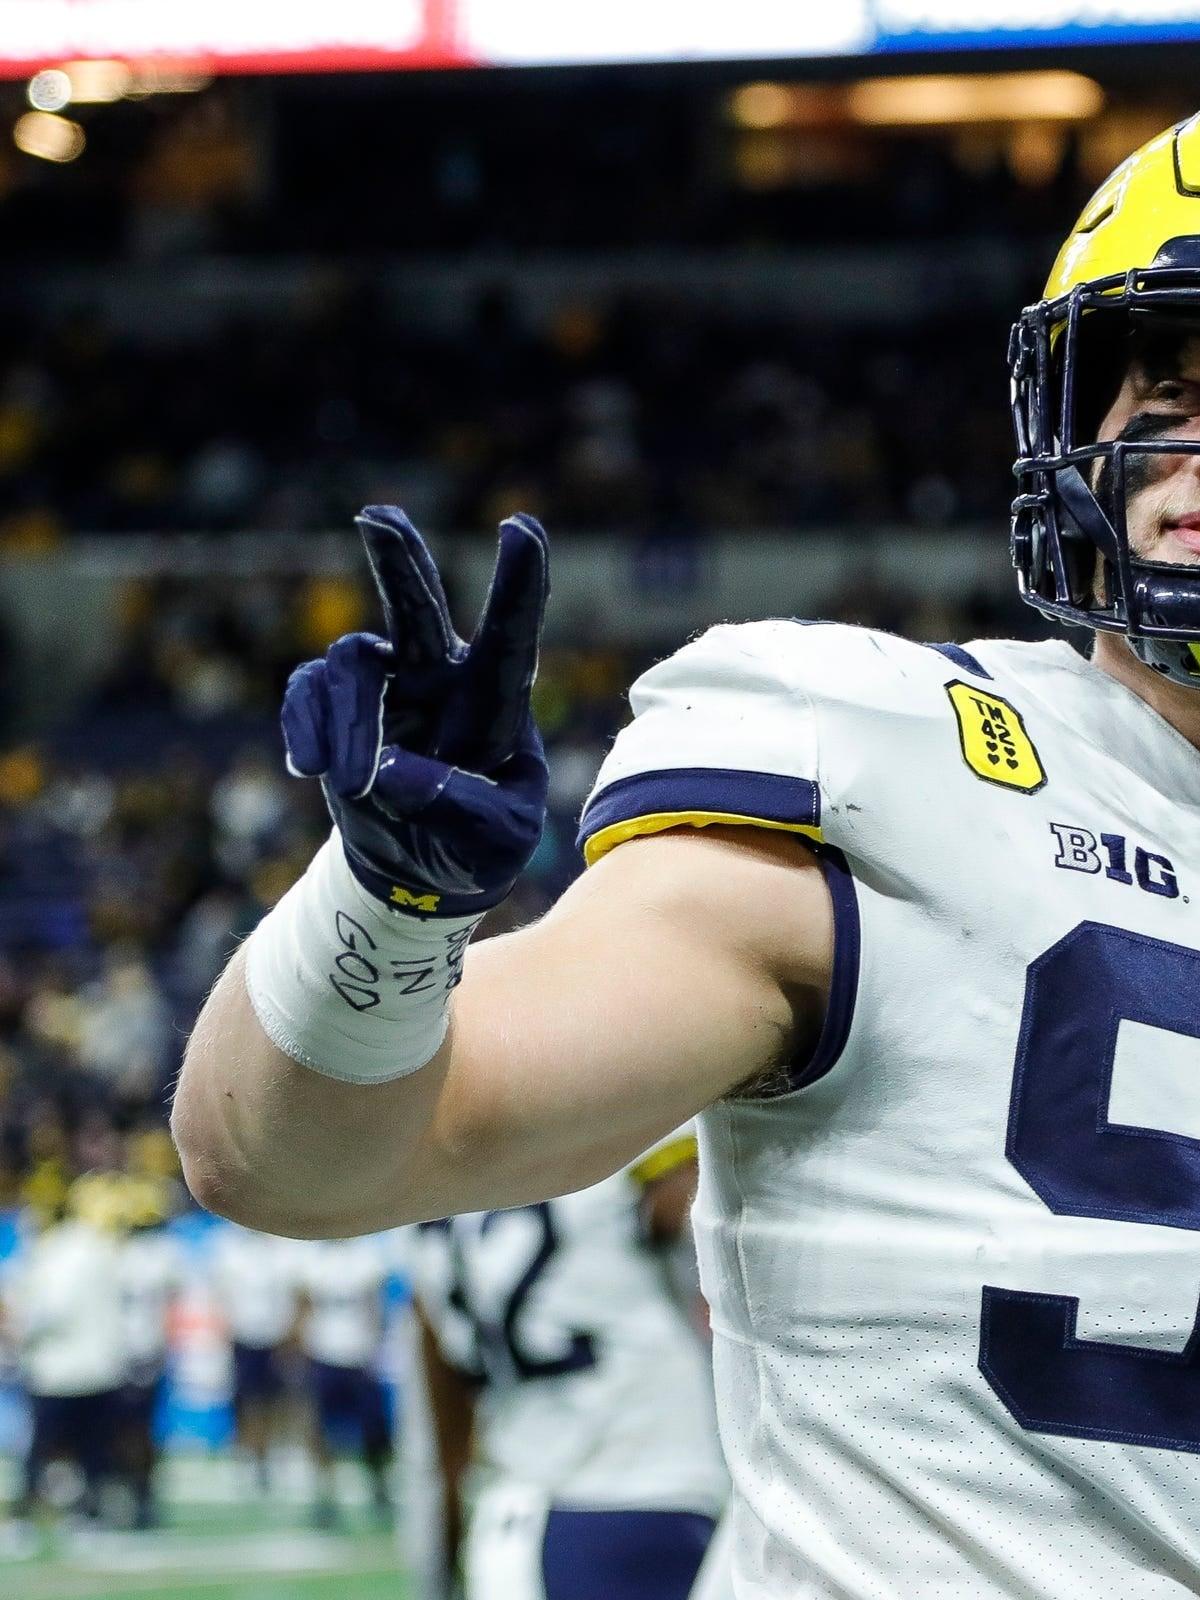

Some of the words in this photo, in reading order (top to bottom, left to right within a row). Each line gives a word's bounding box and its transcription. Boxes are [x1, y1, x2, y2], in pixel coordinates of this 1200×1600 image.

[982, 719, 1016, 747] 42
[390, 886, 440, 912] M
[329, 910, 381, 1012] GOD
